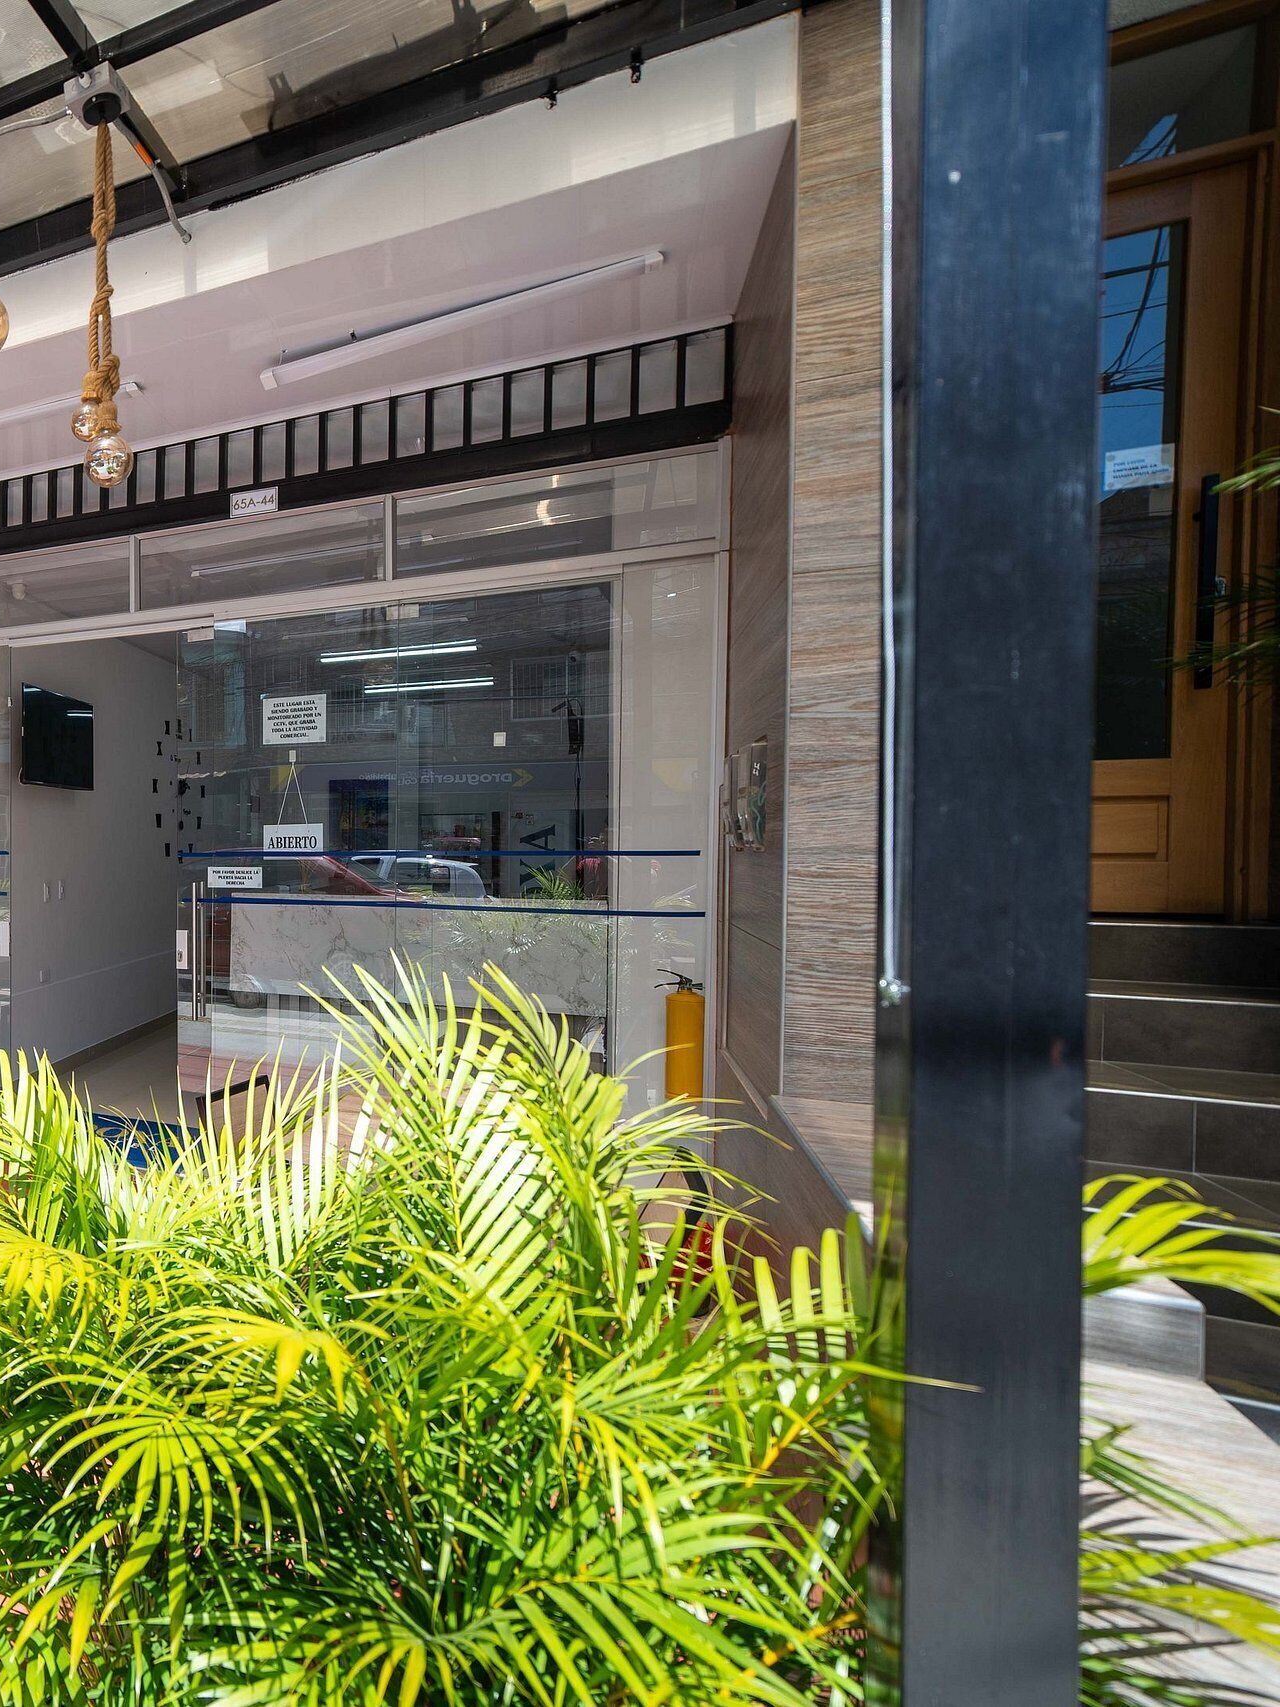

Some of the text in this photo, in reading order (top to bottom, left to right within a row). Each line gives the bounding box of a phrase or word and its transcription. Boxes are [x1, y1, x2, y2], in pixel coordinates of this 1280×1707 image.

[233, 493, 275, 511] 65A-44
[267, 713, 302, 721] MONITOREADO
[267, 835, 318, 849] ABIERTO
